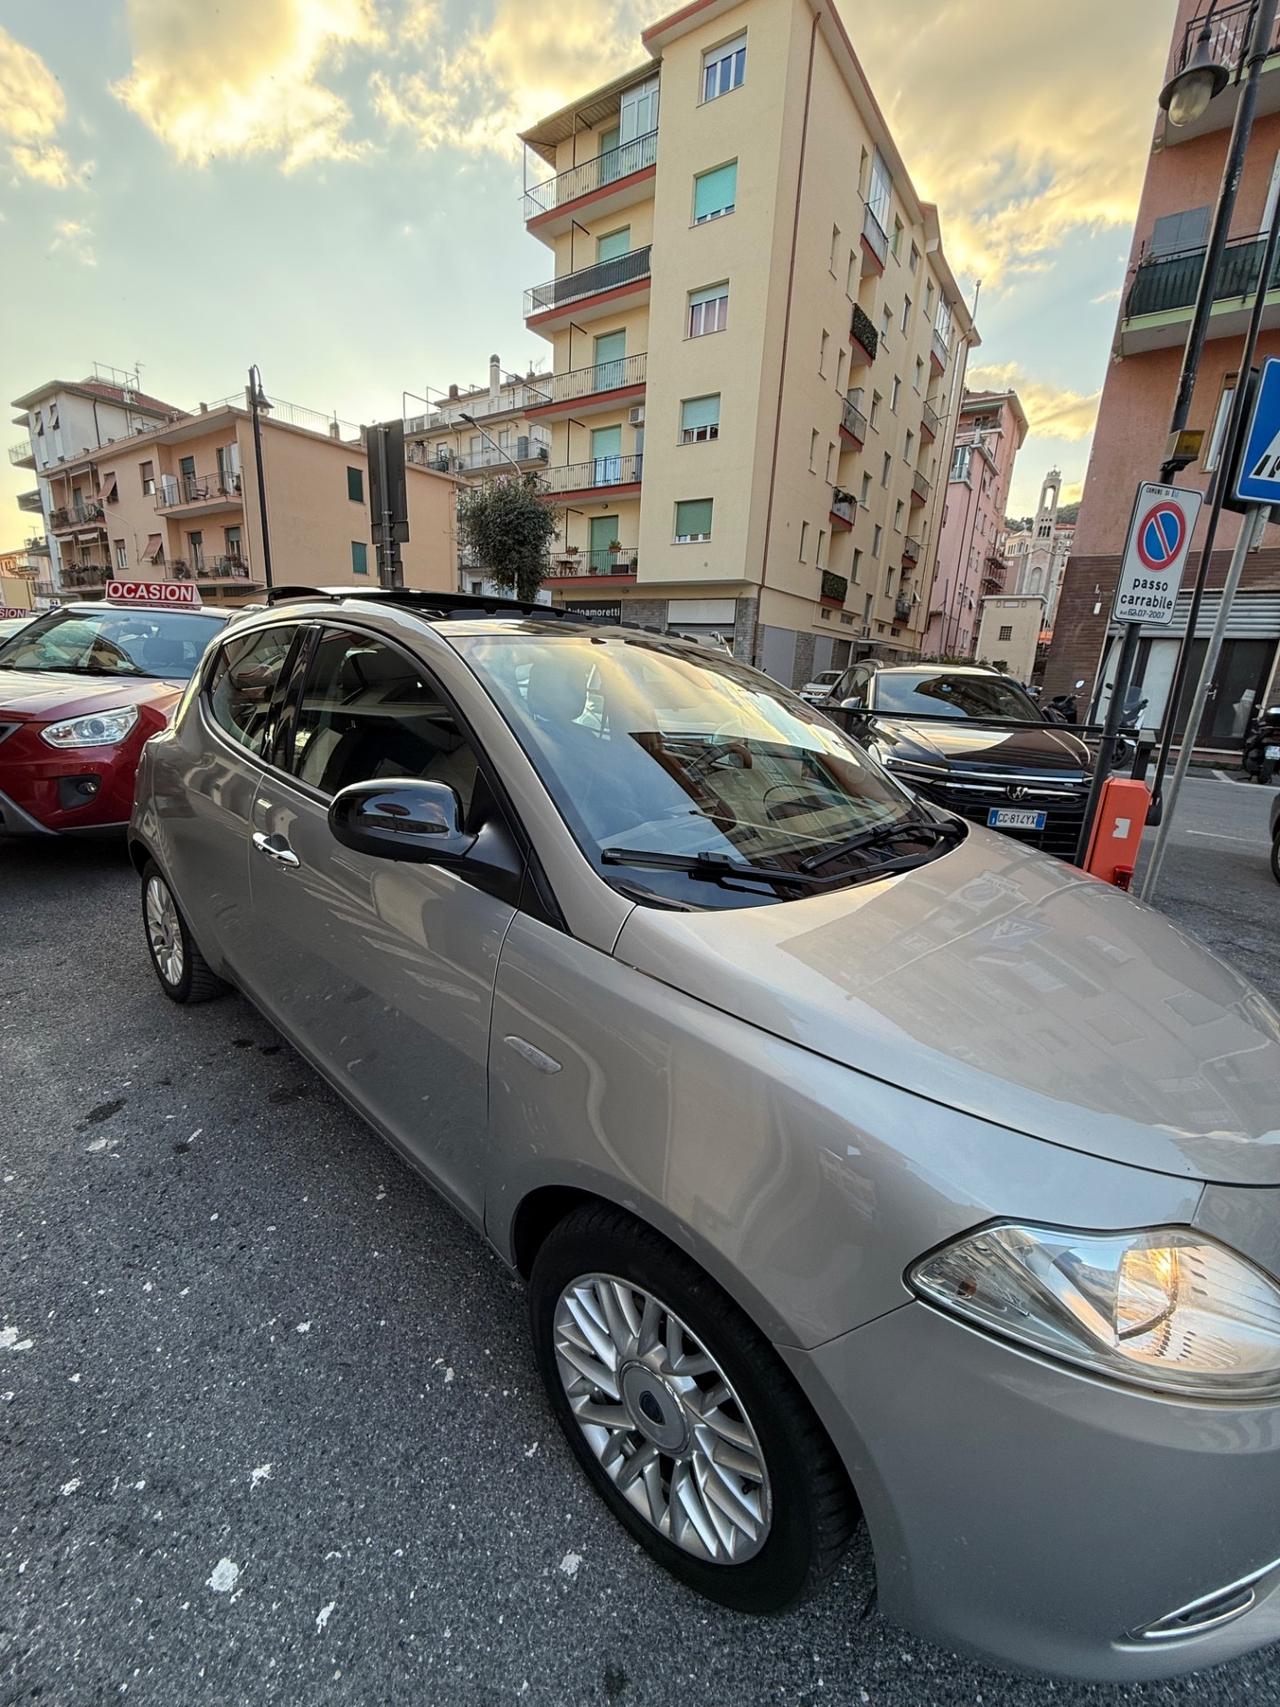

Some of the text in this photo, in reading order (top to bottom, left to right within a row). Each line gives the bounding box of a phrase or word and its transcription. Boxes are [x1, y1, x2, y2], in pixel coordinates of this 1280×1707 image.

[109, 583, 192, 600] OCASION
[1133, 578, 1168, 591] passo
[1120, 594, 1173, 609] carrabile
